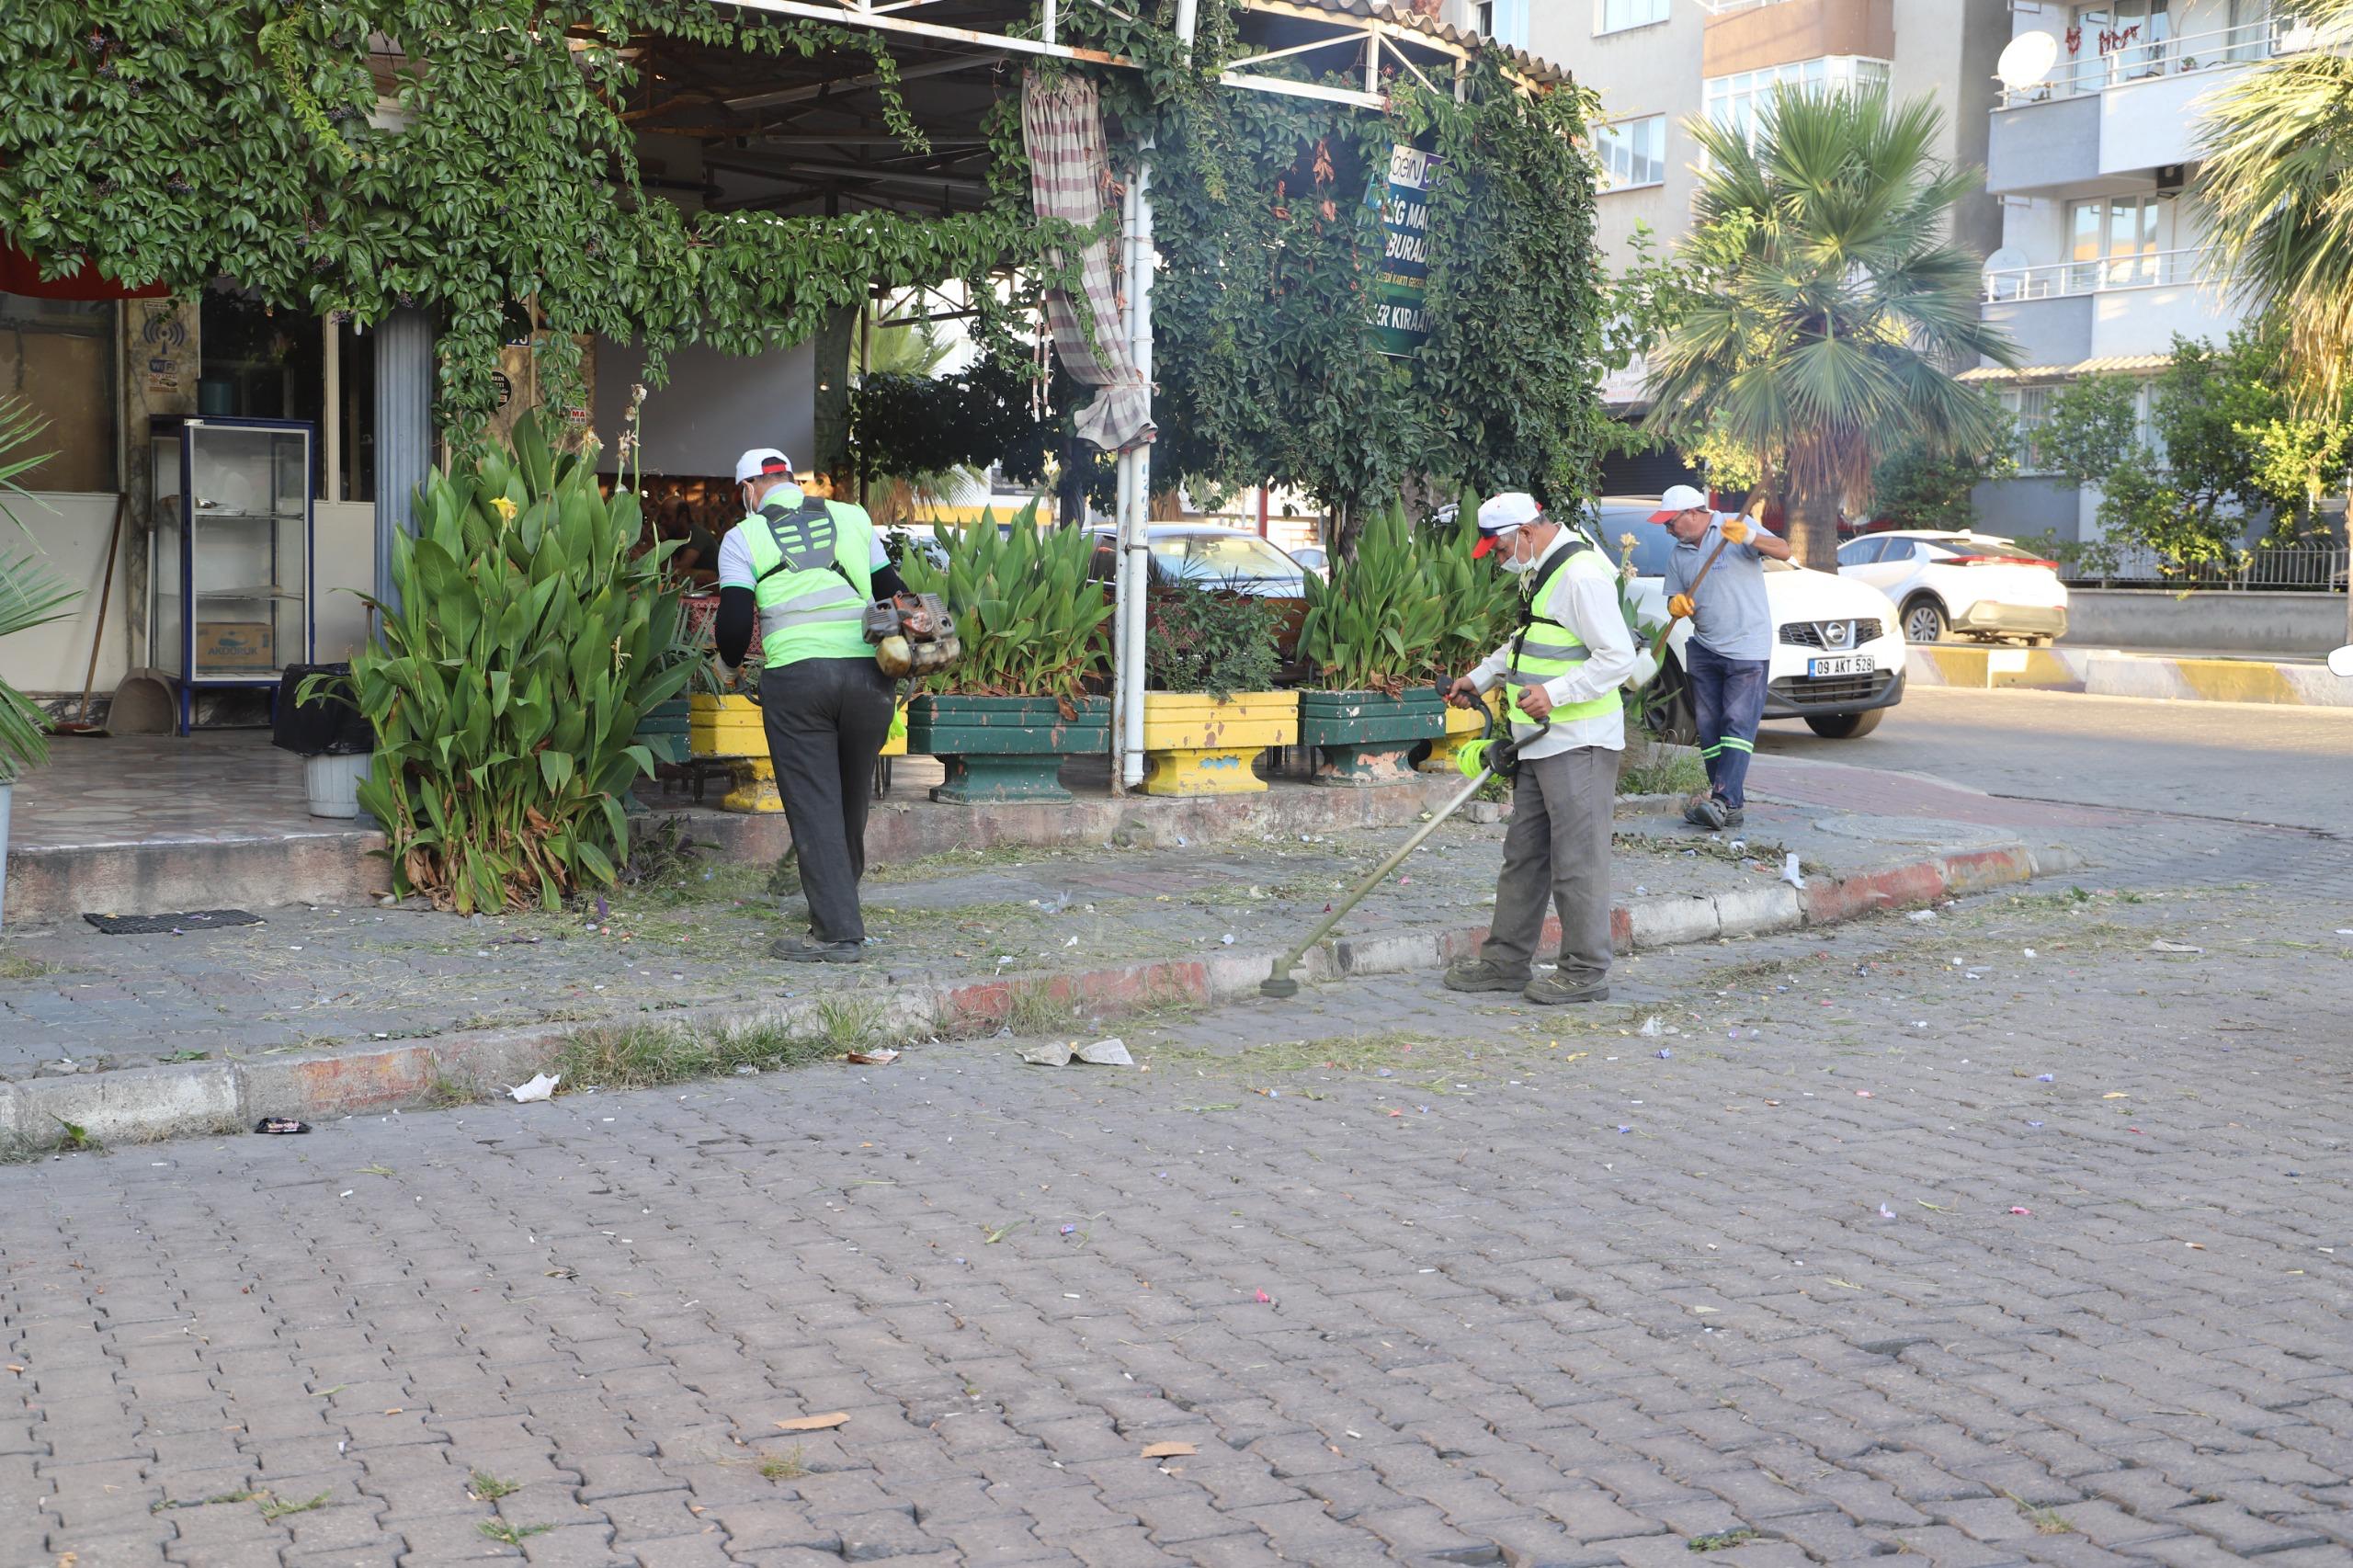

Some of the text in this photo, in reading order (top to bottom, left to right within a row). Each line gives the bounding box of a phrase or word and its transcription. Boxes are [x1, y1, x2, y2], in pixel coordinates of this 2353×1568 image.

[1385, 232, 1429, 264] BURAD
[1817, 658, 1871, 674] 09 AKT 528
